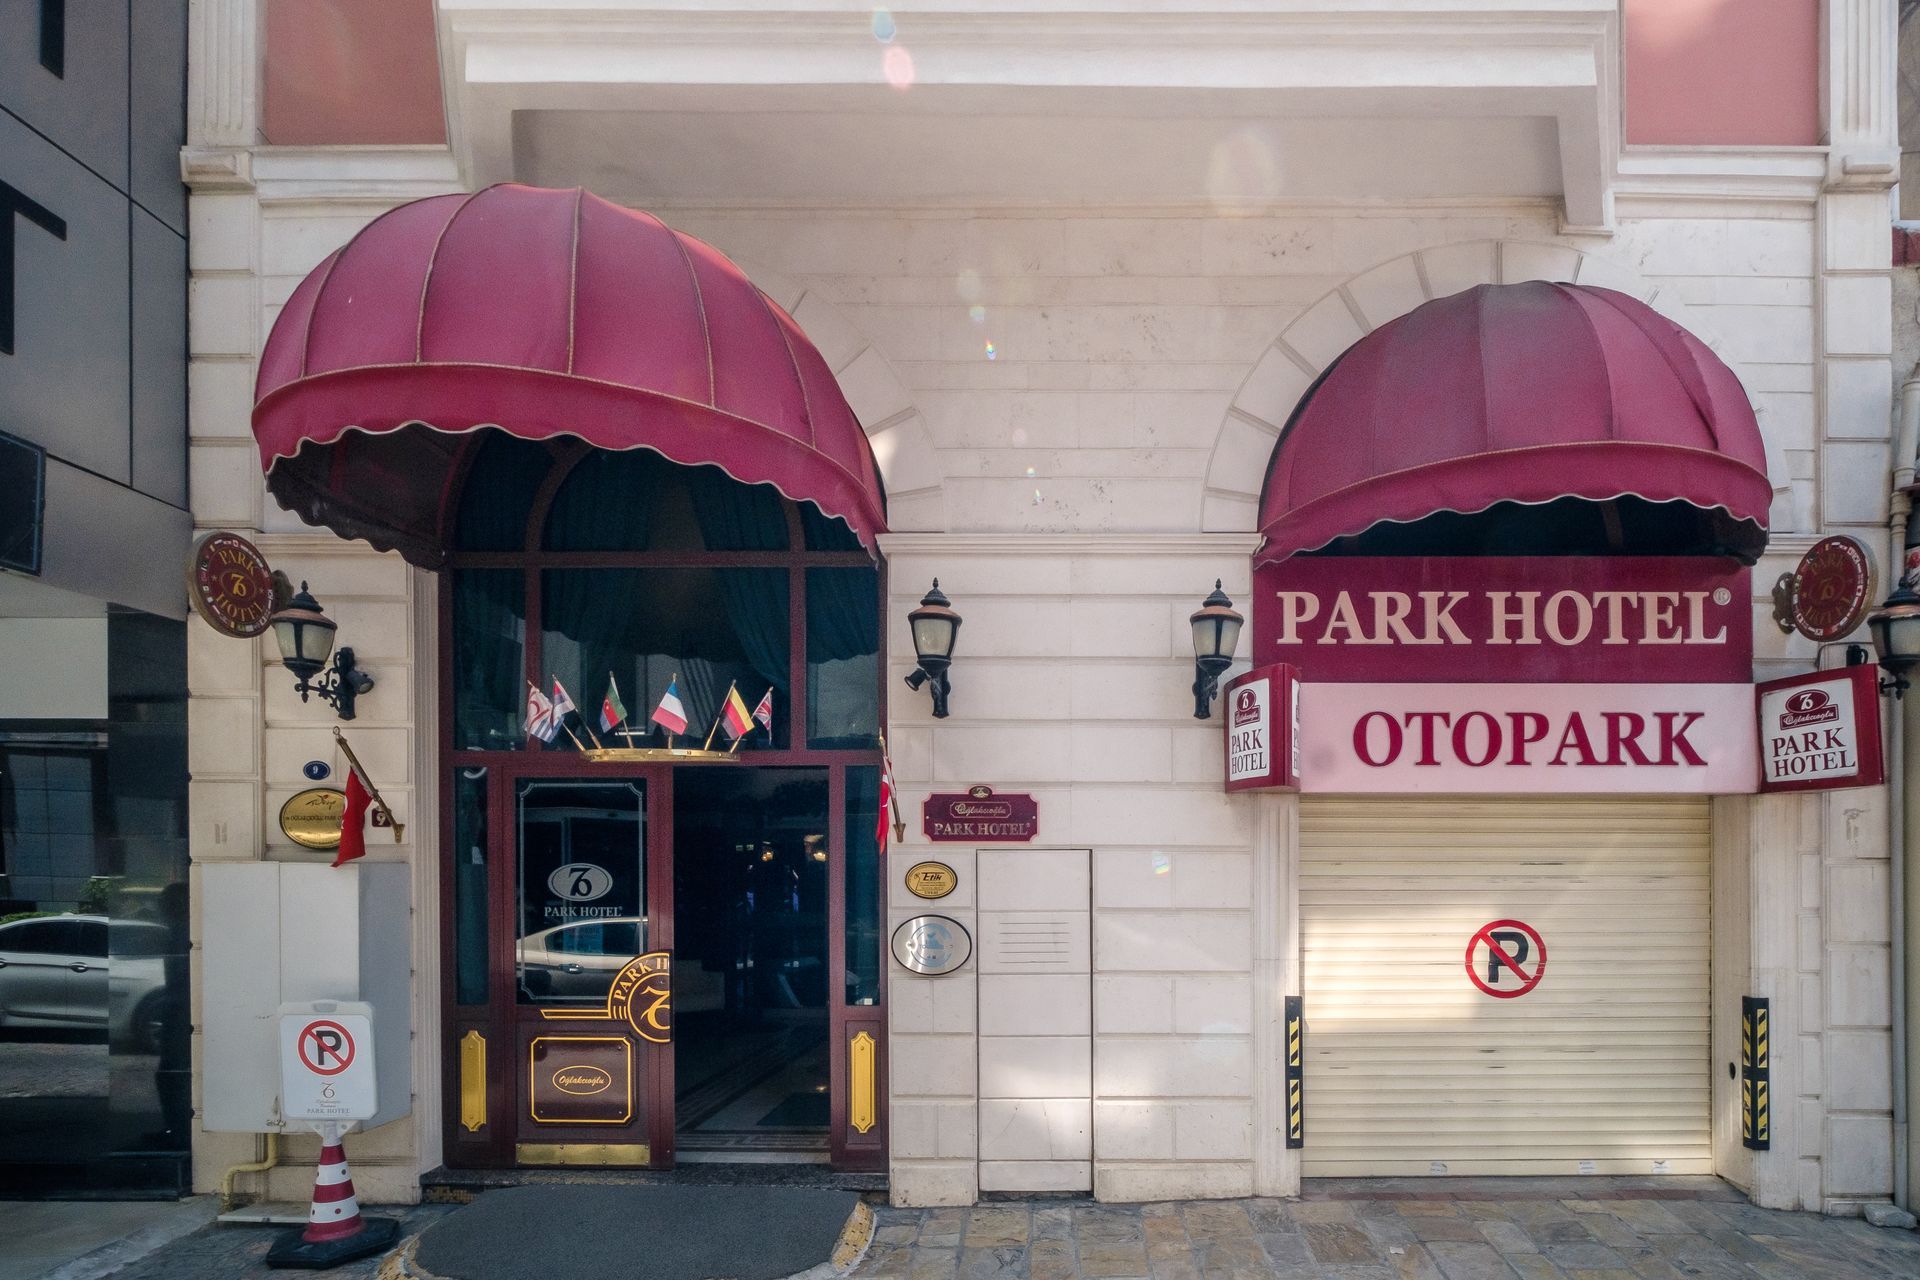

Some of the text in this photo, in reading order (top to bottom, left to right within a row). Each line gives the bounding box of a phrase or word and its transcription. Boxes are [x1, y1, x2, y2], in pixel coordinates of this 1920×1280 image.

[219, 549, 254, 576] PARK
[216, 592, 263, 622] HOTEL
[1276, 590, 1472, 645] PARK
[1231, 728, 1263, 755] PARK
[1352, 710, 1708, 768] OTOPARK
[1771, 726, 1846, 758] PARK
[312, 765, 319, 775] 9
[1231, 751, 1267, 775] HOTEL
[1774, 749, 1856, 778] HOTEL
[376, 811, 387, 827] 9
[934, 822, 976, 836] PARK
[544, 906, 578, 917] PARK
[613, 961, 653, 1001] PARK
[307, 1107, 351, 1115] PARK HOTEL
